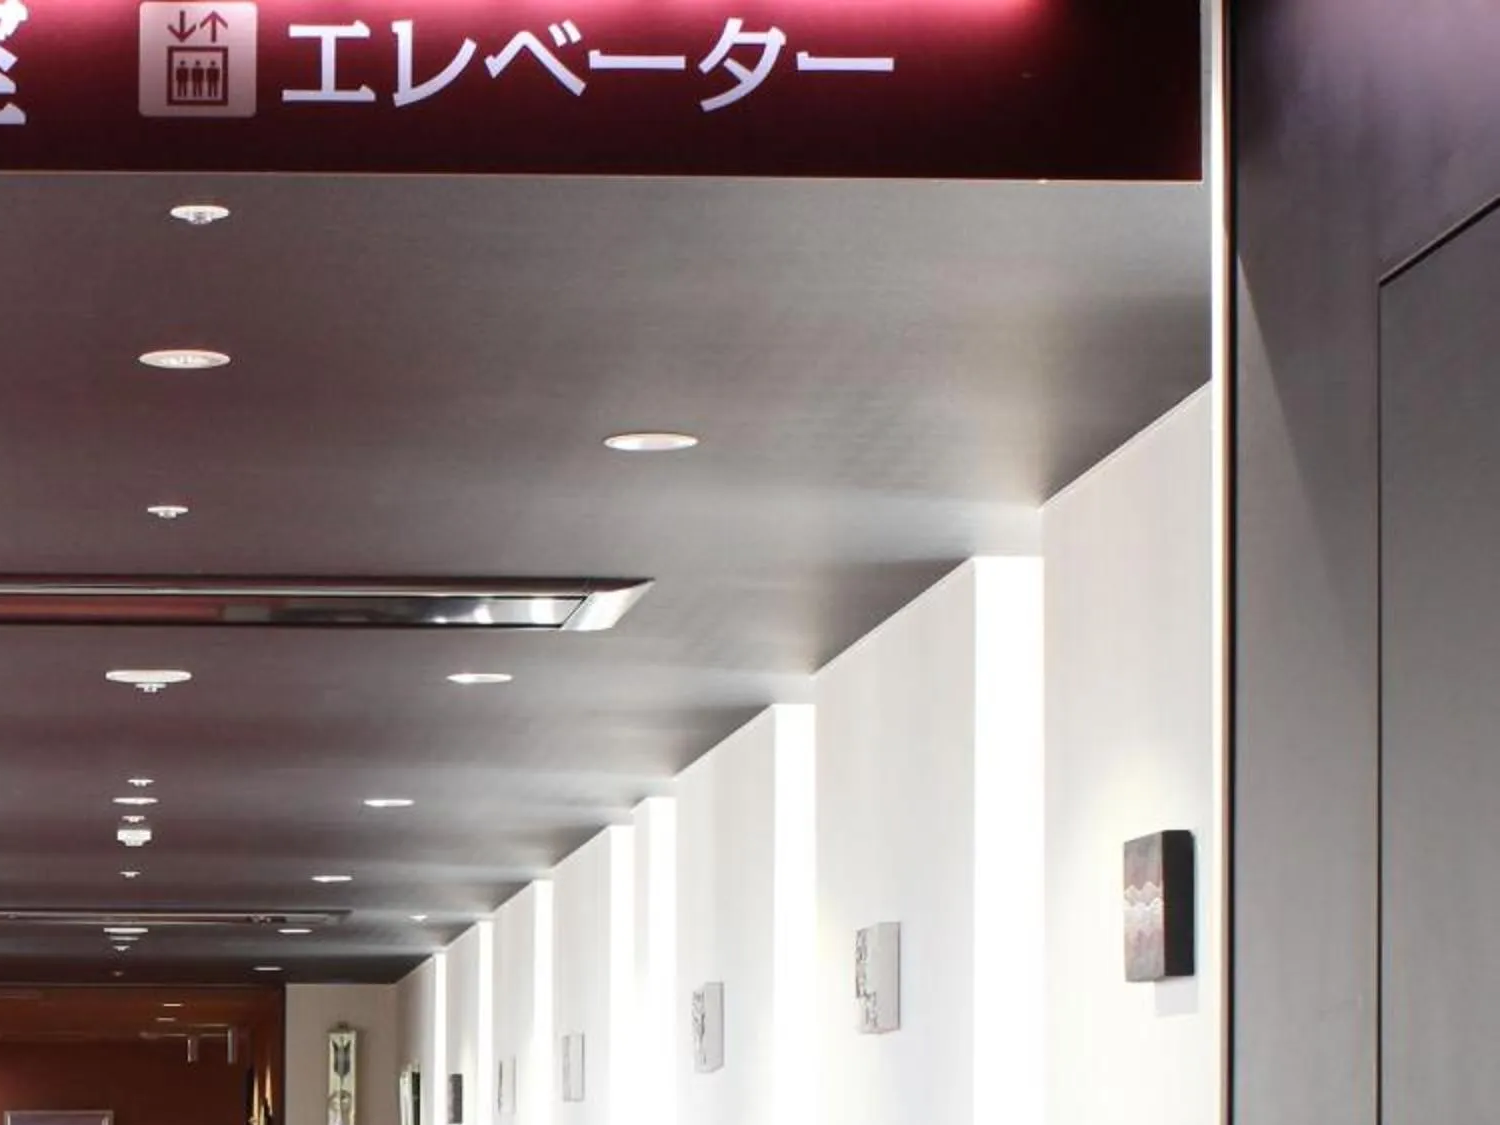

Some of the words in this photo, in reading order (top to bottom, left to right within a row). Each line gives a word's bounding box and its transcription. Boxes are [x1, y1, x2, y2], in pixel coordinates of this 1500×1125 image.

[281, 16, 895, 112] エレベーター
